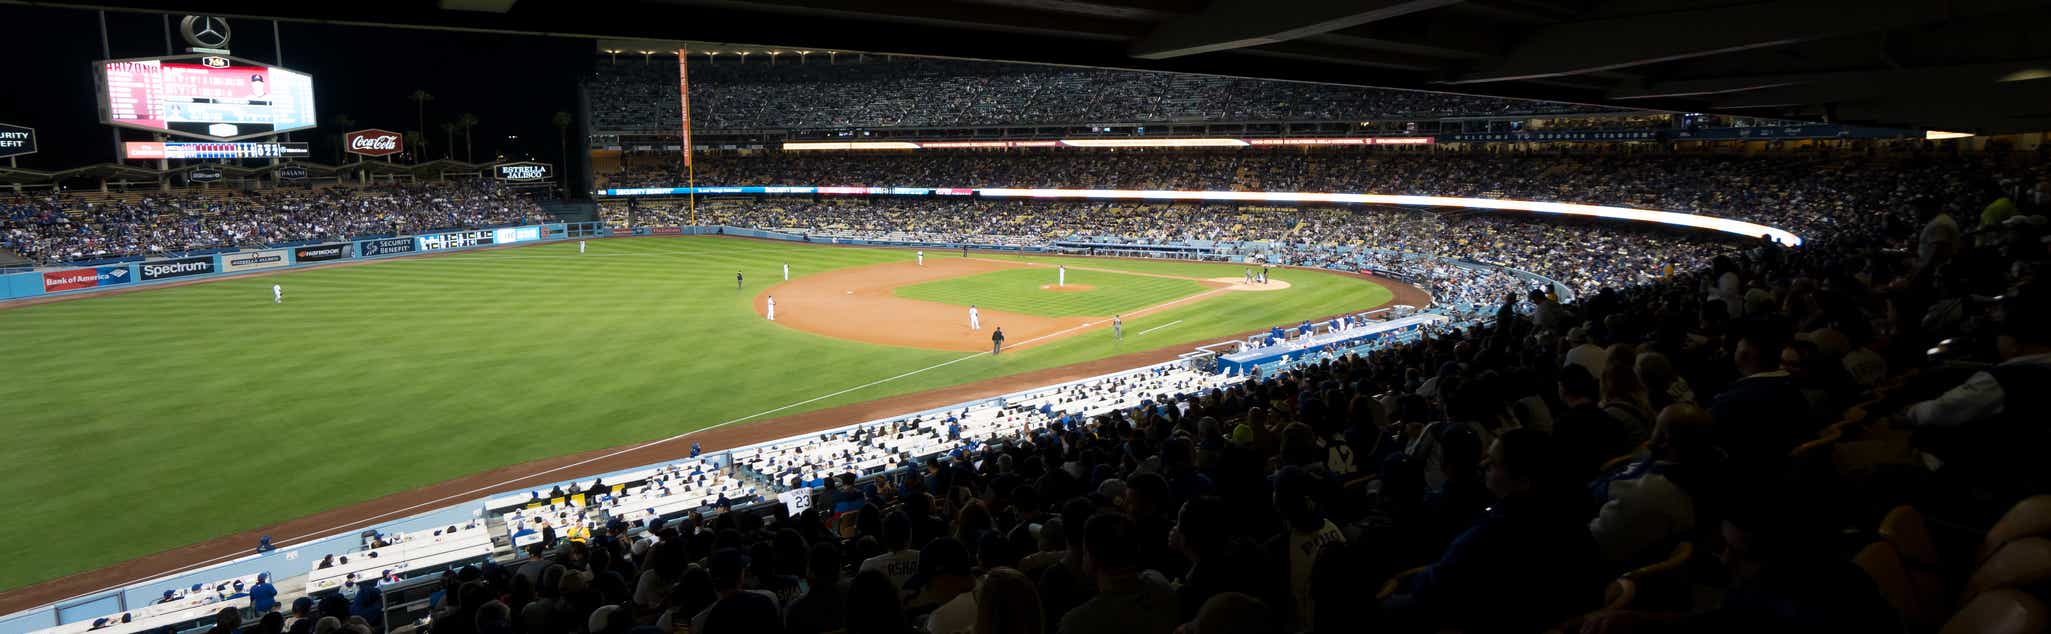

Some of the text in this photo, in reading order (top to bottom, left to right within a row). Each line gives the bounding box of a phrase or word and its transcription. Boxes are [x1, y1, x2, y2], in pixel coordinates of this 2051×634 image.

[104, 61, 159, 74] ARIZONA
[352, 135, 398, 150] Coca-Cola
[502, 166, 546, 174] ESTRELLA
[507, 170, 542, 179] JALISCO
[380, 239, 411, 247] SECURITY
[144, 261, 207, 277] Spectrum
[46, 278, 68, 286] Bank
[77, 274, 110, 283] America
[795, 494, 810, 508] 23
